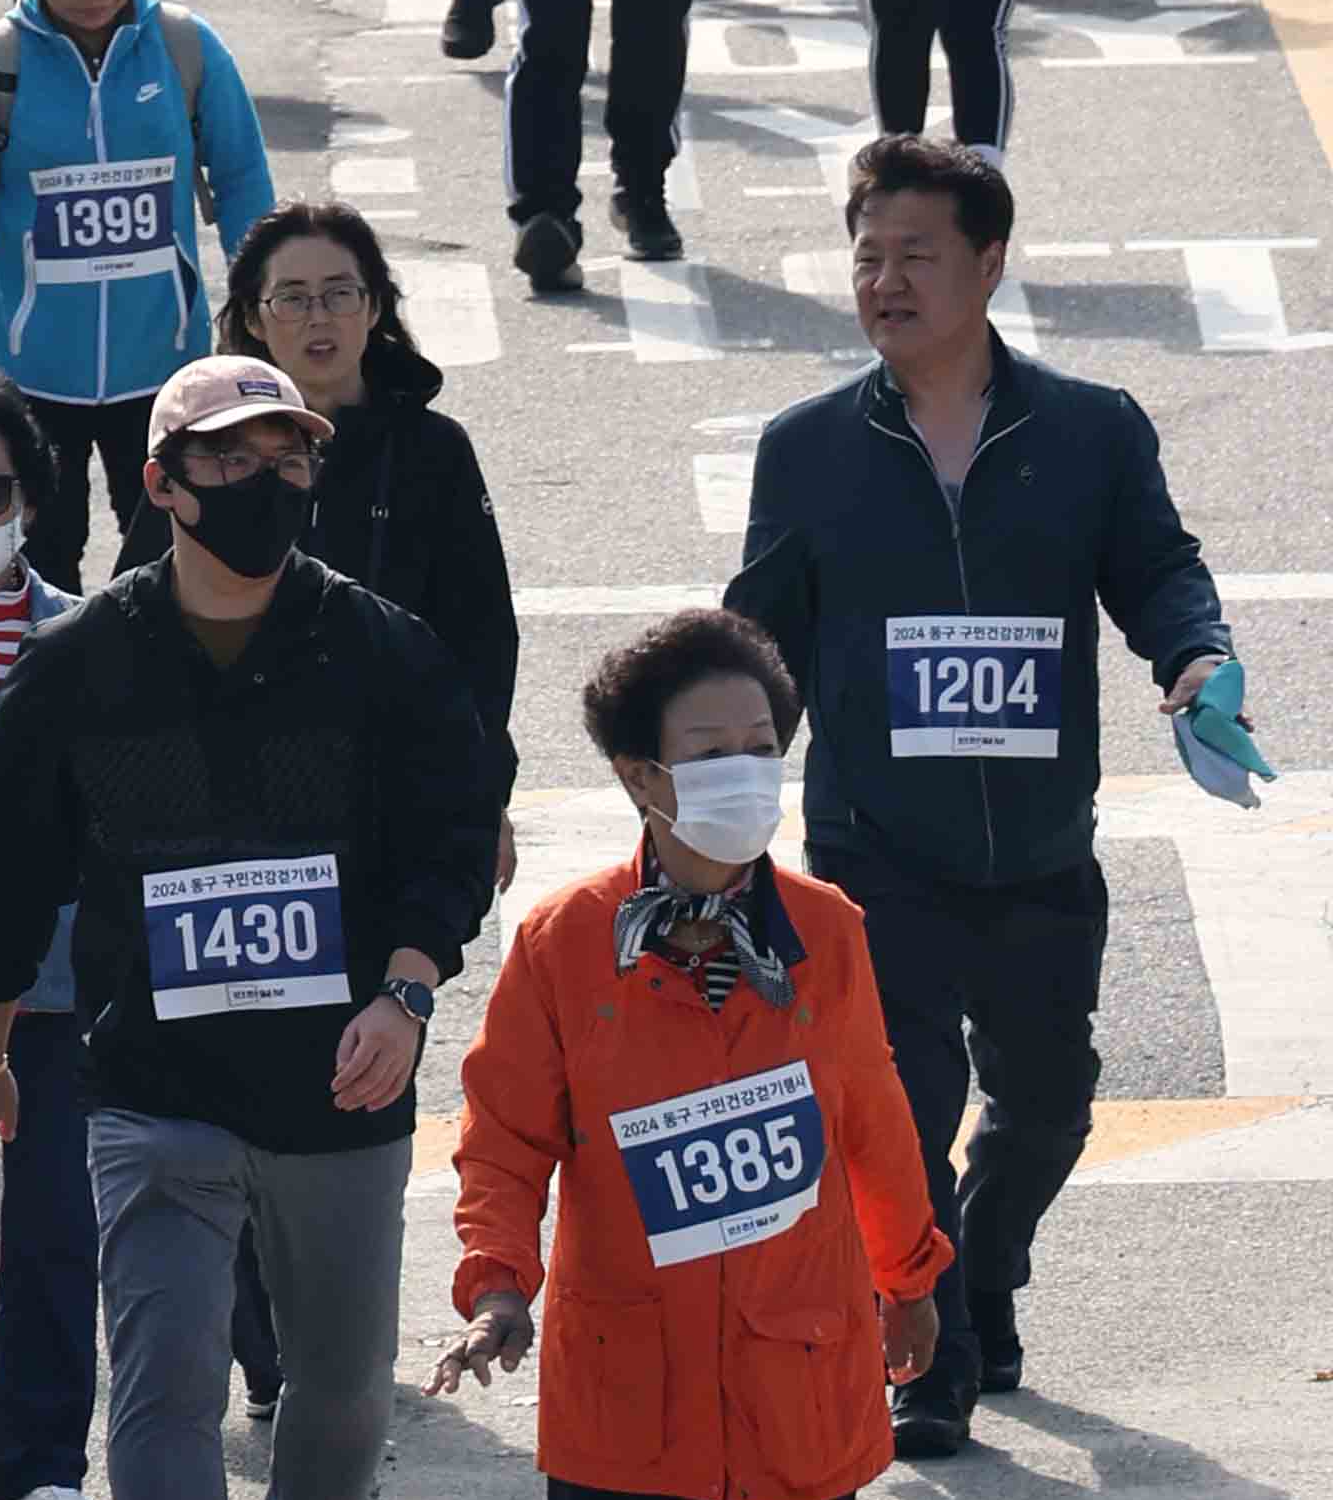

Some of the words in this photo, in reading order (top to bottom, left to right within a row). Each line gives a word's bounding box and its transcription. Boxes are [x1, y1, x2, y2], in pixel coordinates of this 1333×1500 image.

[55, 193, 158, 247] 1399
[893, 627, 926, 642] 2024
[930, 626, 955, 641] 동구
[913, 656, 1039, 714] 1204
[151, 881, 187, 899] 2024
[191, 875, 218, 894] 동구
[222, 864, 333, 889] 구민건강걷기행사
[174, 900, 318, 972] 1430
[620, 1117, 661, 1139] 2024
[663, 1107, 692, 1130] 동구
[696, 1072, 807, 1119] 구민건강걷기행사
[654, 1114, 804, 1212] 1385
